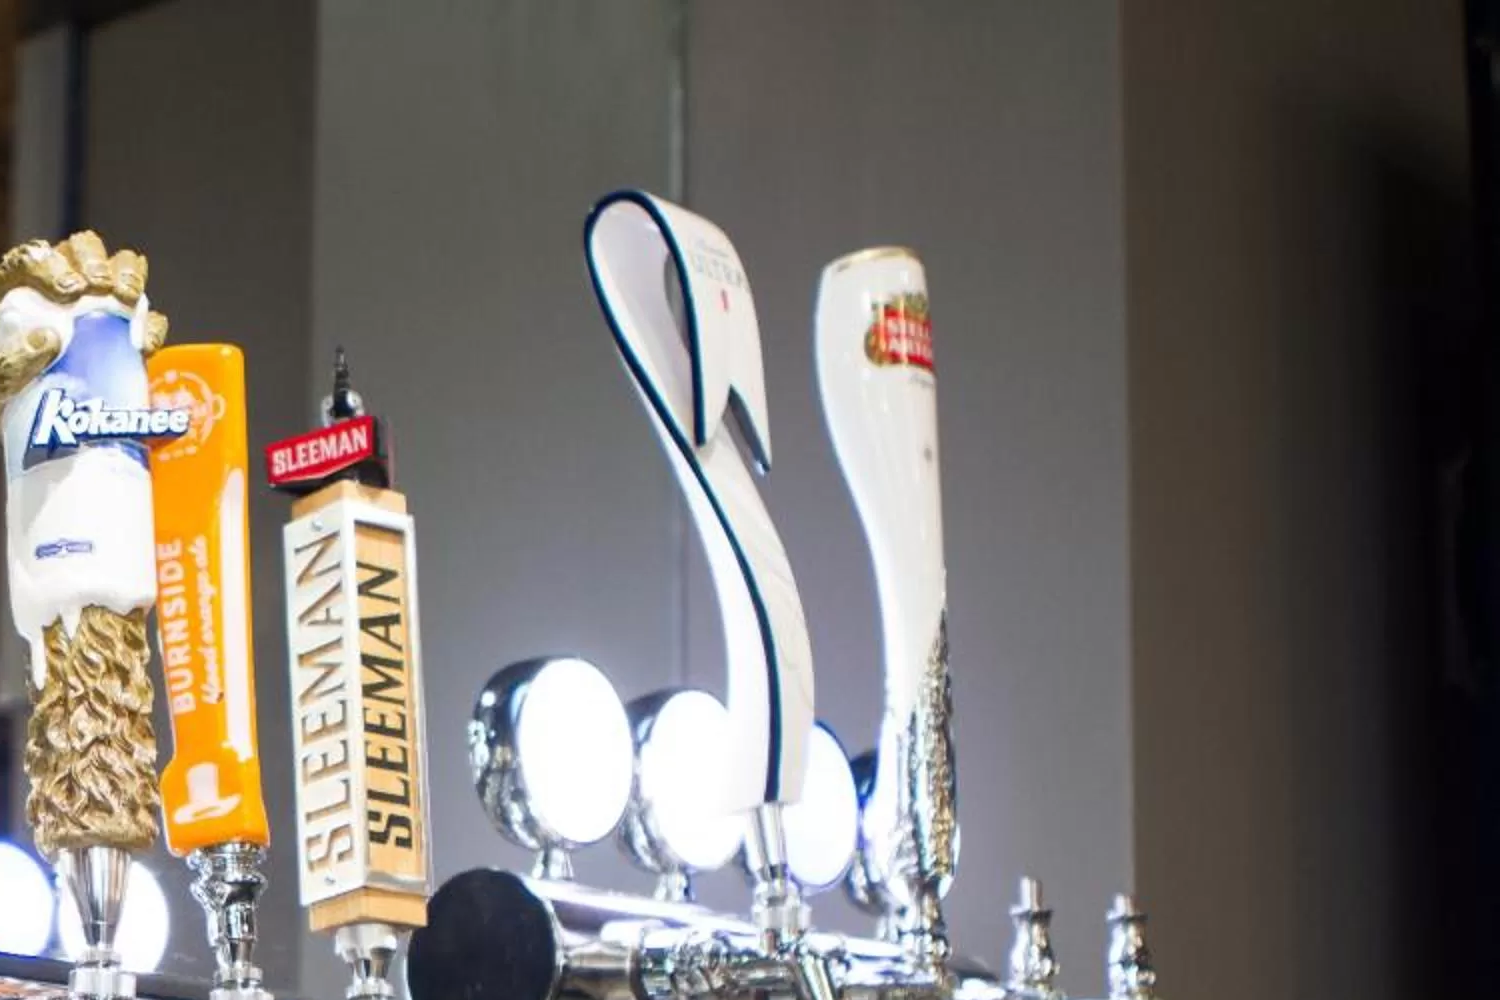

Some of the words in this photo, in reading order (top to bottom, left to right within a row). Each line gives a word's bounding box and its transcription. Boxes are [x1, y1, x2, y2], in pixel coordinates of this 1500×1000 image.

[30, 388, 190, 449] Kokanee
[272, 425, 368, 476] SLEEMAN
[158, 538, 197, 715] BURNSIDE
[294, 528, 356, 875] SLEEMAN
[356, 561, 413, 849] SLEEMAN
